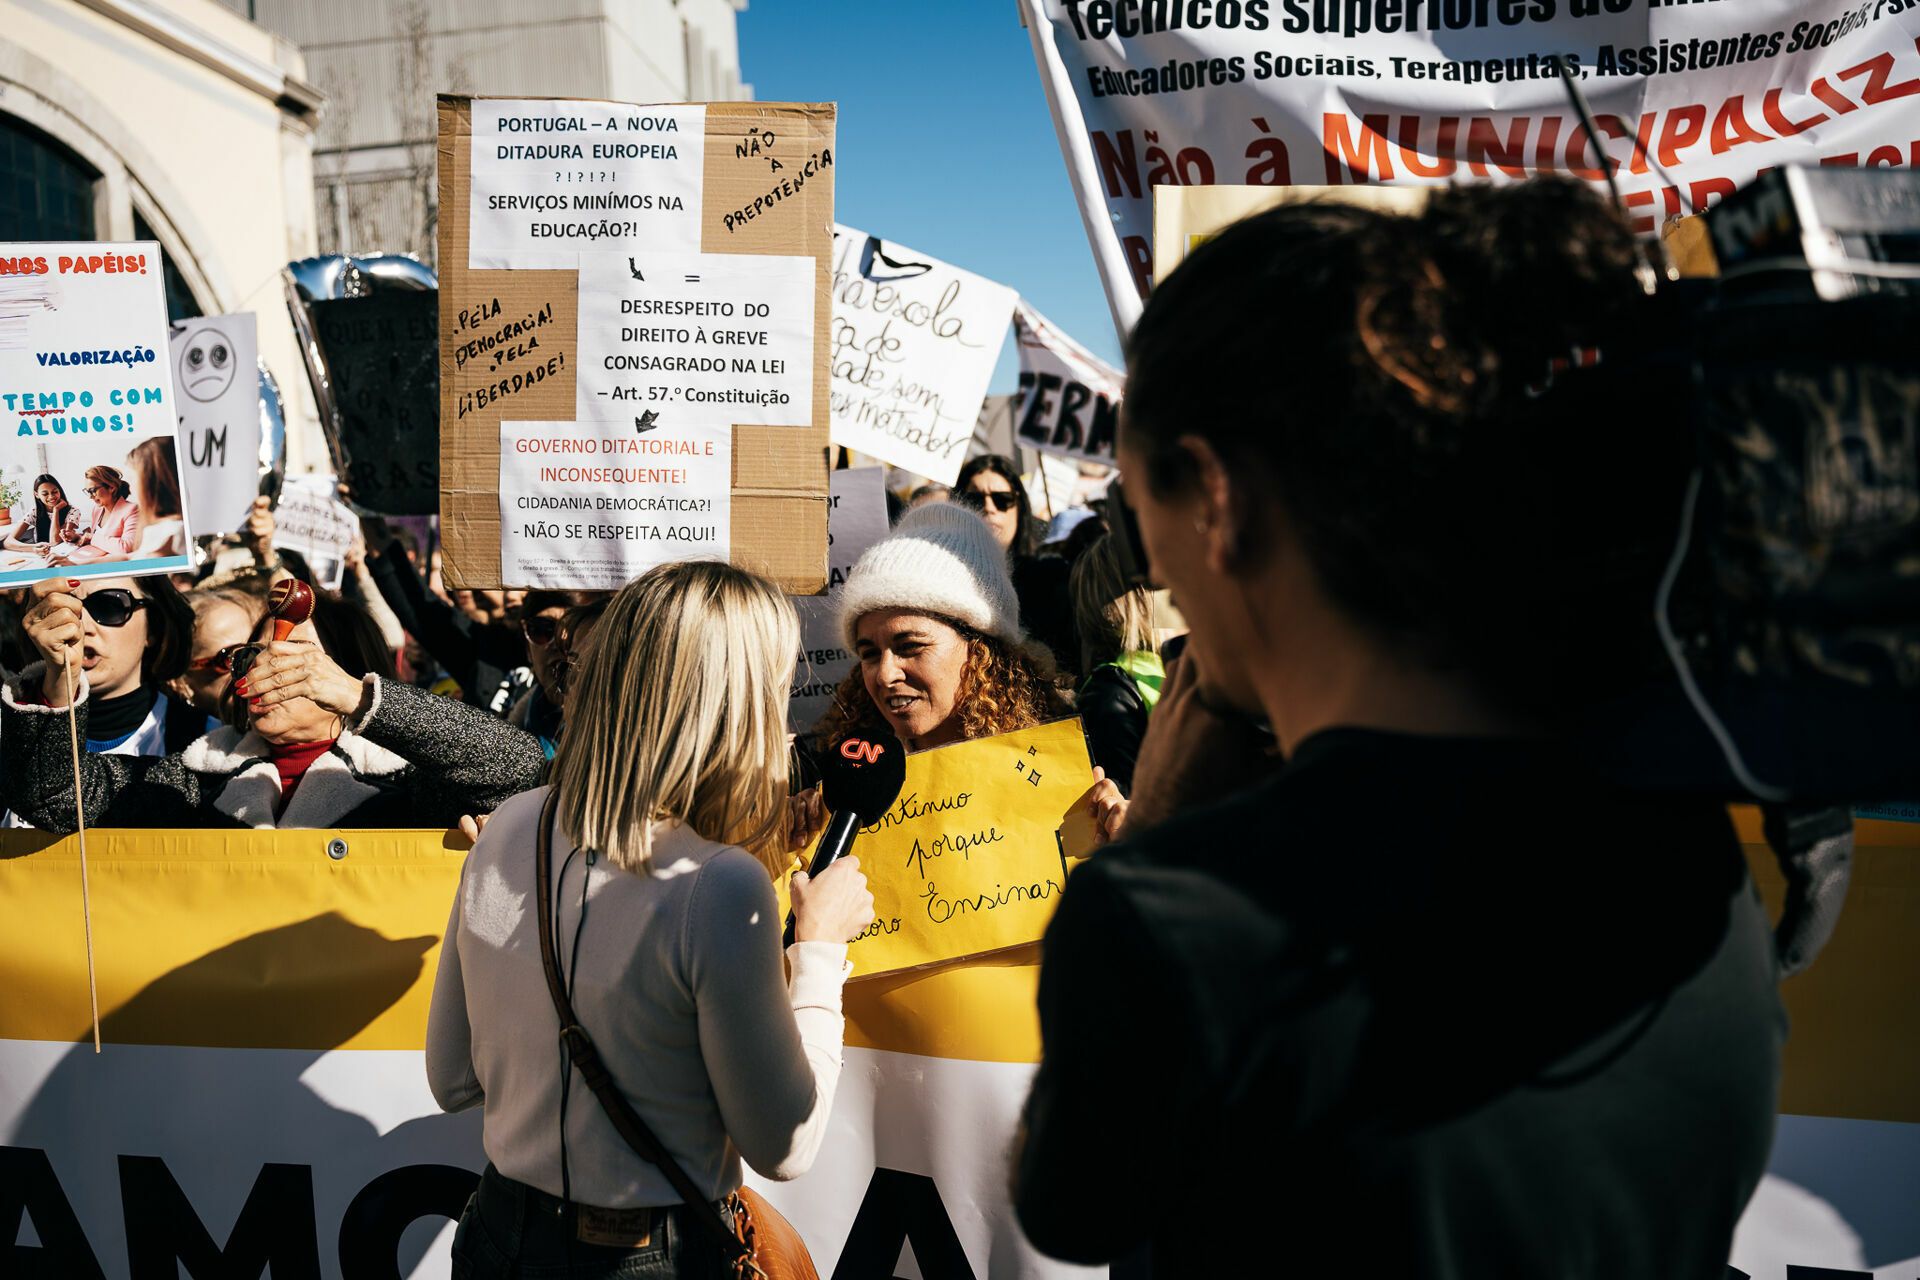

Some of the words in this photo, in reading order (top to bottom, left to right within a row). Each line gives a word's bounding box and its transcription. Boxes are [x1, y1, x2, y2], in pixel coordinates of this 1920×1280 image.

[1087, 56, 1245, 98] Educadores
[1254, 51, 1382, 80] Sociais,
[1389, 53, 1587, 84] Terapeutas,
[1596, 30, 1785, 76] Assistentes
[499, 118, 587, 132] PORTUGAL
[606, 118, 617, 130] A
[628, 117, 678, 131] NOVA
[1090, 129, 1215, 199] Não
[1245, 117, 1292, 186] à
[1323, 37, 1920, 186] MUNICIPALIZ
[498, 145, 583, 159] DITADURA
[593, 144, 677, 159] EUROPEIA
[736, 127, 775, 158] NÃO
[489, 196, 567, 212] SERVIÇOS
[574, 191, 652, 209] MINÍMOS
[659, 196, 683, 210] NA
[532, 220, 636, 240] EDUCAÇÃO?!
[0, 256, 49, 275] NOS
[621, 300, 733, 316] DESRESPEITO
[745, 304, 769, 317] DO
[455, 303, 553, 371] DEMOCRACIA!
[622, 328, 689, 343] DIREITO
[695, 326, 706, 343] À
[713, 331, 767, 345] GREVE
[36, 346, 156, 369] VALORIZAÇÃO
[604, 356, 726, 372] CONSAGRADO
[732, 359, 756, 373] NA
[763, 360, 784, 373] LEI
[458, 352, 565, 419] LIBERDADE!
[3, 390, 94, 411] TEMPO
[110, 387, 162, 406] COM
[612, 386, 642, 400] Art.
[685, 388, 789, 407] Constituição
[17, 413, 134, 437] ALUNOS!
[190, 424, 227, 468] UM
[516, 439, 596, 453] GOVERNO
[602, 439, 699, 455] DITATORIAL
[705, 442, 713, 455] E
[541, 468, 685, 484] INCONSEQUENTE!
[518, 497, 592, 509] CIDADANIA
[597, 496, 710, 511] DEMOCRÁTICA?!
[525, 521, 559, 538] NÃO
[565, 525, 582, 538] SE
[589, 525, 661, 540] RESPEITA
[666, 527, 714, 542] AQUI!
[860, 791, 972, 835] ontinuo
[907, 827, 1004, 880] porque
[920, 881, 1064, 924] Ensinar
